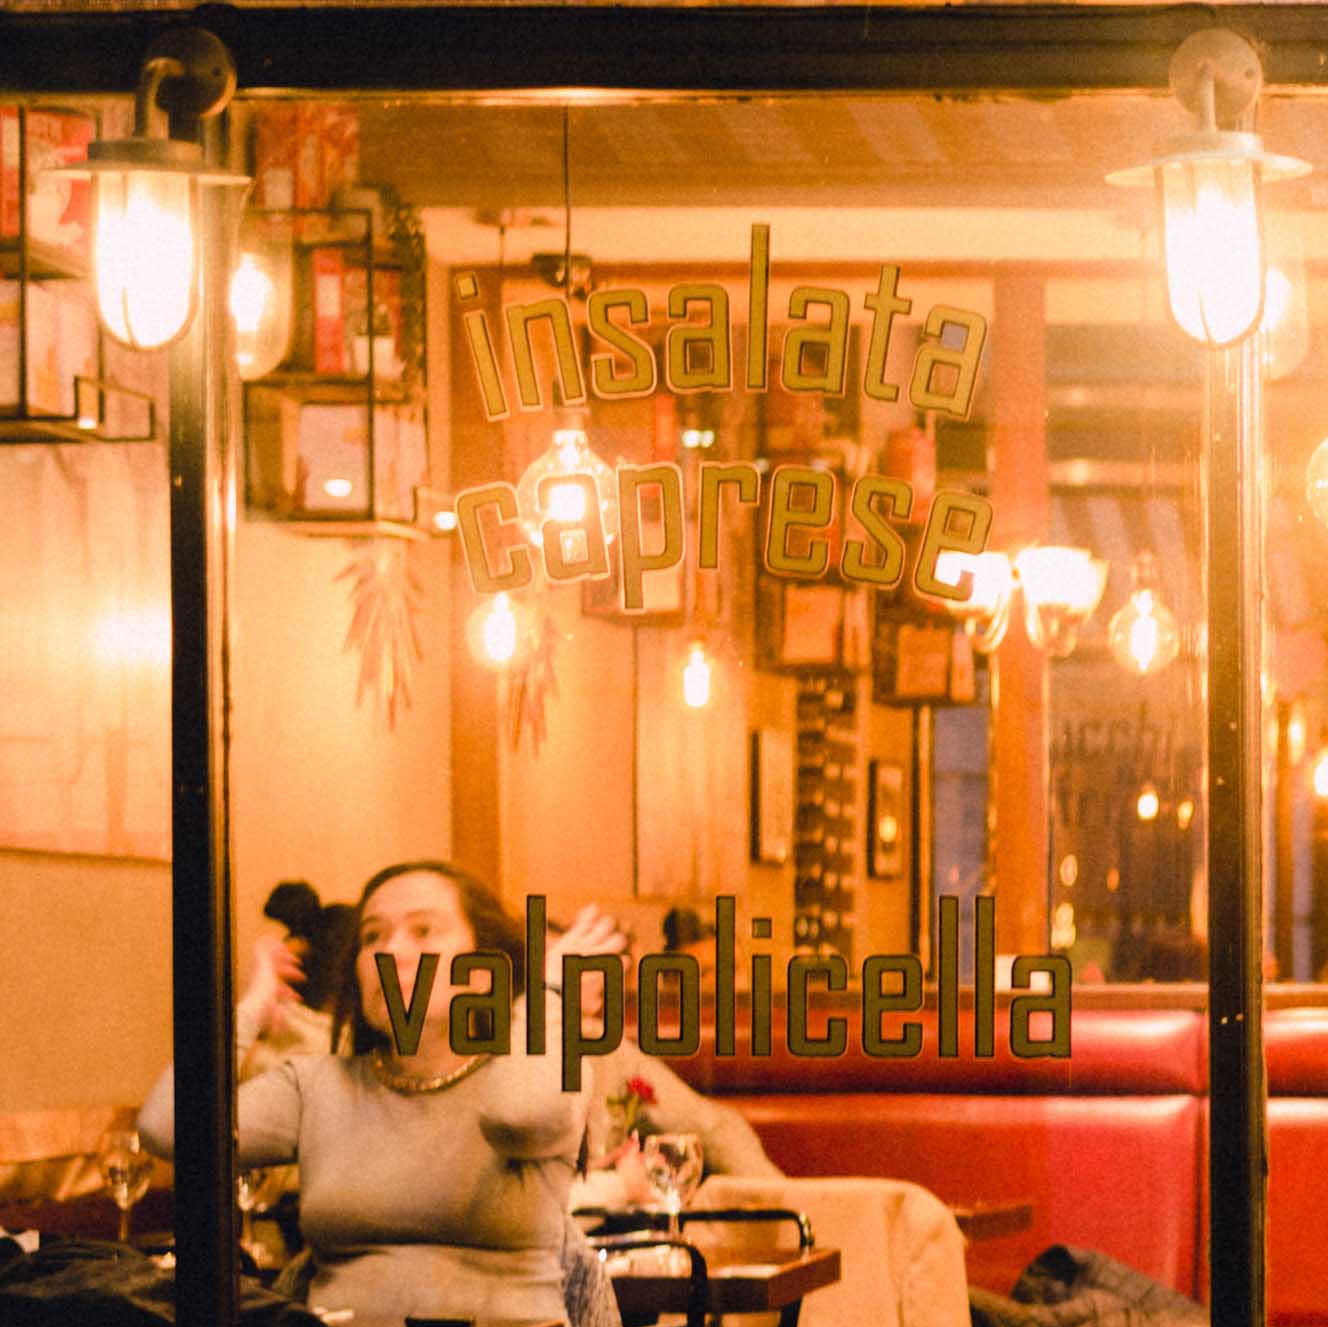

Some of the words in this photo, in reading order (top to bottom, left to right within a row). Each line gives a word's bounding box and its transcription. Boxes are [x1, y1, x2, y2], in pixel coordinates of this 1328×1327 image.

[455, 224, 989, 421] insalata
[454, 461, 996, 611] caprese
[375, 895, 1071, 1092] valpolicella
